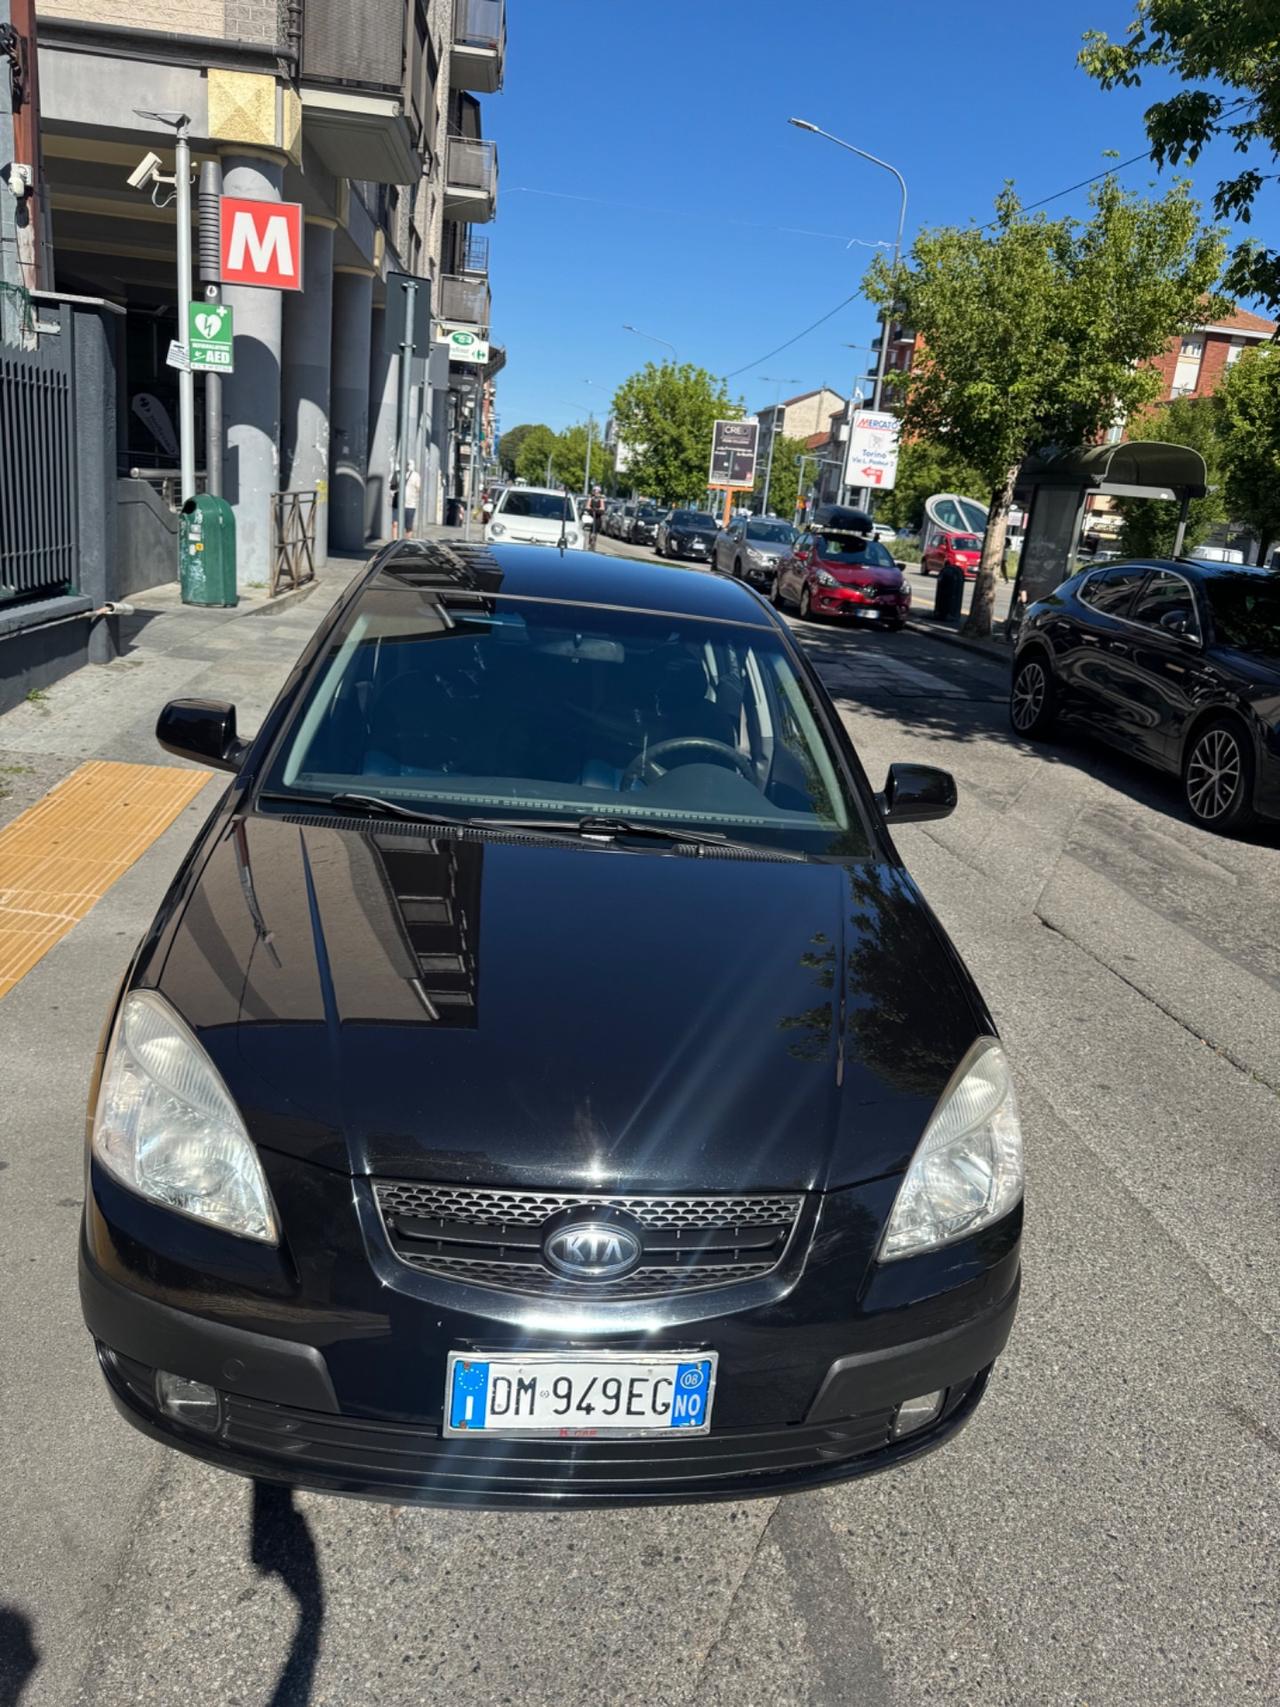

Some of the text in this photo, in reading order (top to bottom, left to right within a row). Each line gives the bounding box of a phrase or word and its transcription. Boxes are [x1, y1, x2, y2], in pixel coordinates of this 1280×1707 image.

[227, 211, 294, 276] M
[206, 350, 230, 364] AED
[856, 417, 898, 430] MERCATO
[863, 449, 887, 459] Torino
[563, 1236, 623, 1261] KIA
[685, 1375, 699, 1385] 08
[490, 1376, 537, 1416] DM
[552, 1376, 673, 1416] 949EG
[674, 1394, 700, 1418] NO
